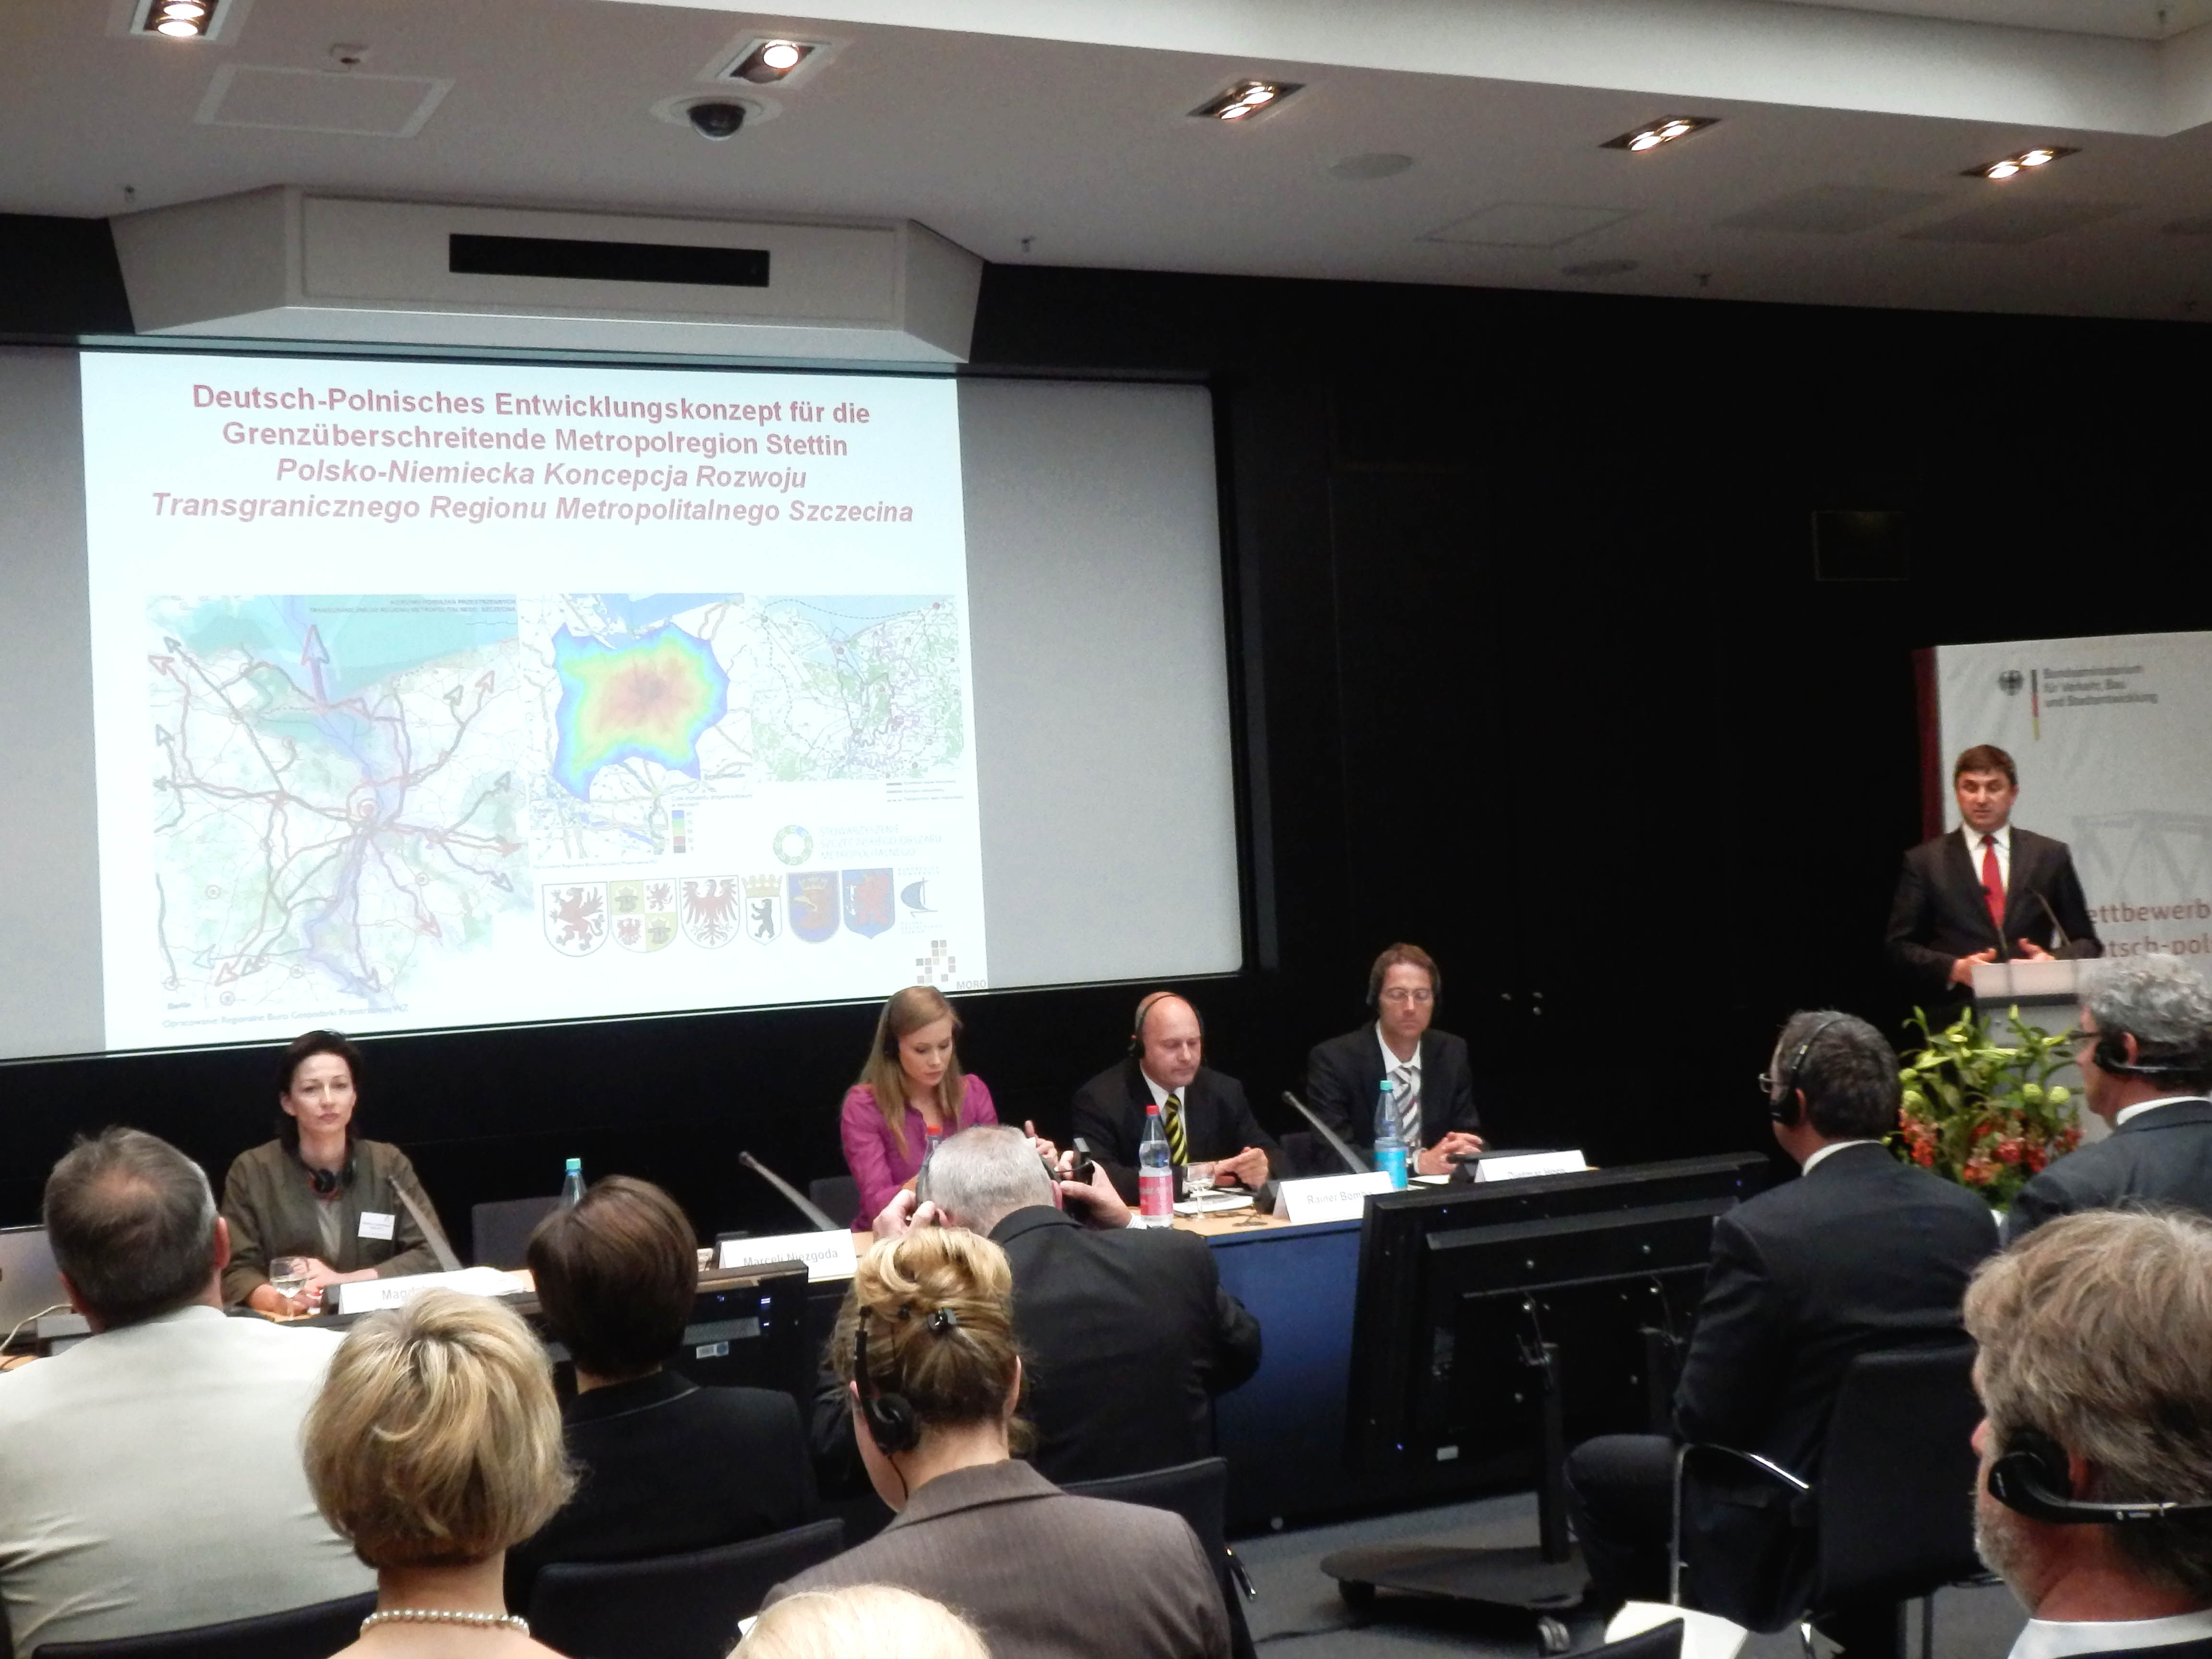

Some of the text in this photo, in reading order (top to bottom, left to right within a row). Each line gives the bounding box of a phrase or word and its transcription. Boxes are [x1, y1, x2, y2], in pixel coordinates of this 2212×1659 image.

[193, 385, 870, 426] Deutsch-Polnisches Entwicklungskonzept für die
[223, 421, 848, 459] Grenzüberschreitende Metropolregion Stettin
[277, 457, 806, 493] Polsko-Niemiecka Koncepcja Rozwoju
[153, 492, 914, 526] Transgranicznego Regionu Metropolitalnego Szczecina
[2088, 898, 2211, 924] ettbewerb
[2104, 933, 2212, 958] tsch-pol
[957, 979, 986, 990] MORO
[1307, 1195, 1337, 1204] Rainer
[744, 1249, 838, 1266] Marceli Niezgoda
